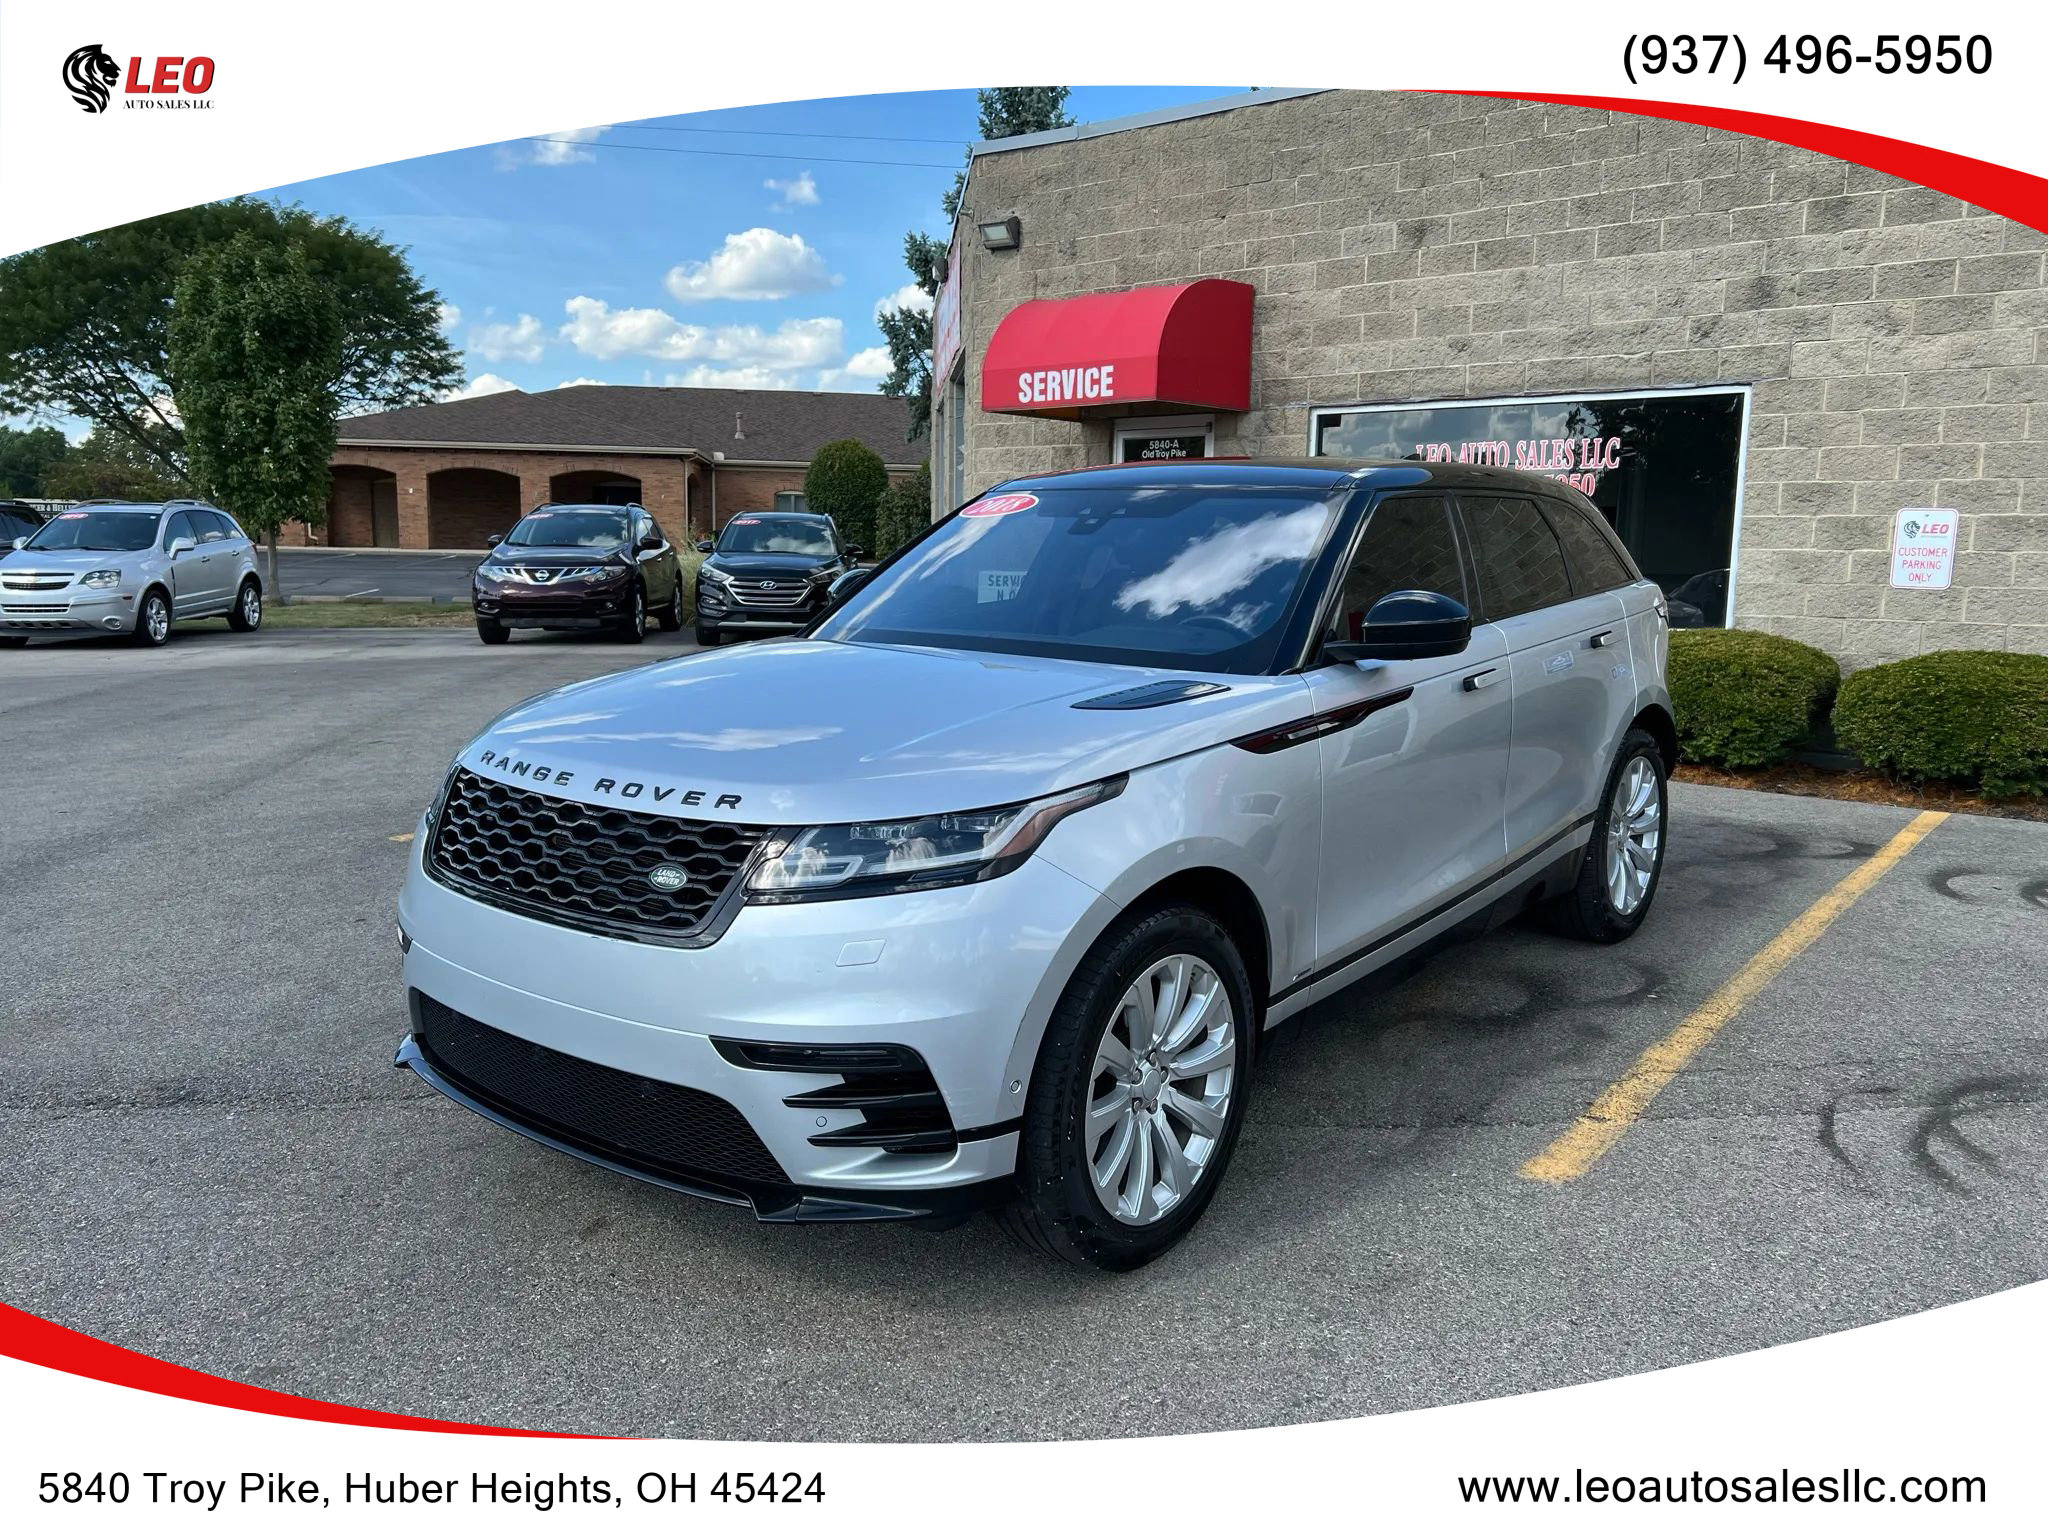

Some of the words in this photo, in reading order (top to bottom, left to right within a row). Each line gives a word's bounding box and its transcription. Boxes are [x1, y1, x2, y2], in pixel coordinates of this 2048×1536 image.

[1018, 365, 1114, 403] SERVICE
[1150, 440, 1179, 449] 5840-A
[1142, 450, 1154, 458] Old
[1156, 450, 1170, 460] Troy
[1171, 449, 1186, 457] Pike
[1459, 441, 1510, 468] AUTO
[1515, 439, 1575, 471] SALES
[1580, 437, 1621, 469] LLC
[1921, 524, 1949, 534] LEO
[1898, 547, 1949, 557] CUSTOMER
[1902, 560, 1942, 570] PARKING
[1909, 573, 1932, 582] ONLY
[480, 750, 574, 786] RANGE
[593, 777, 743, 811] ROVER
[657, 869, 677, 877] LAND
[656, 876, 680, 885] ROVER
